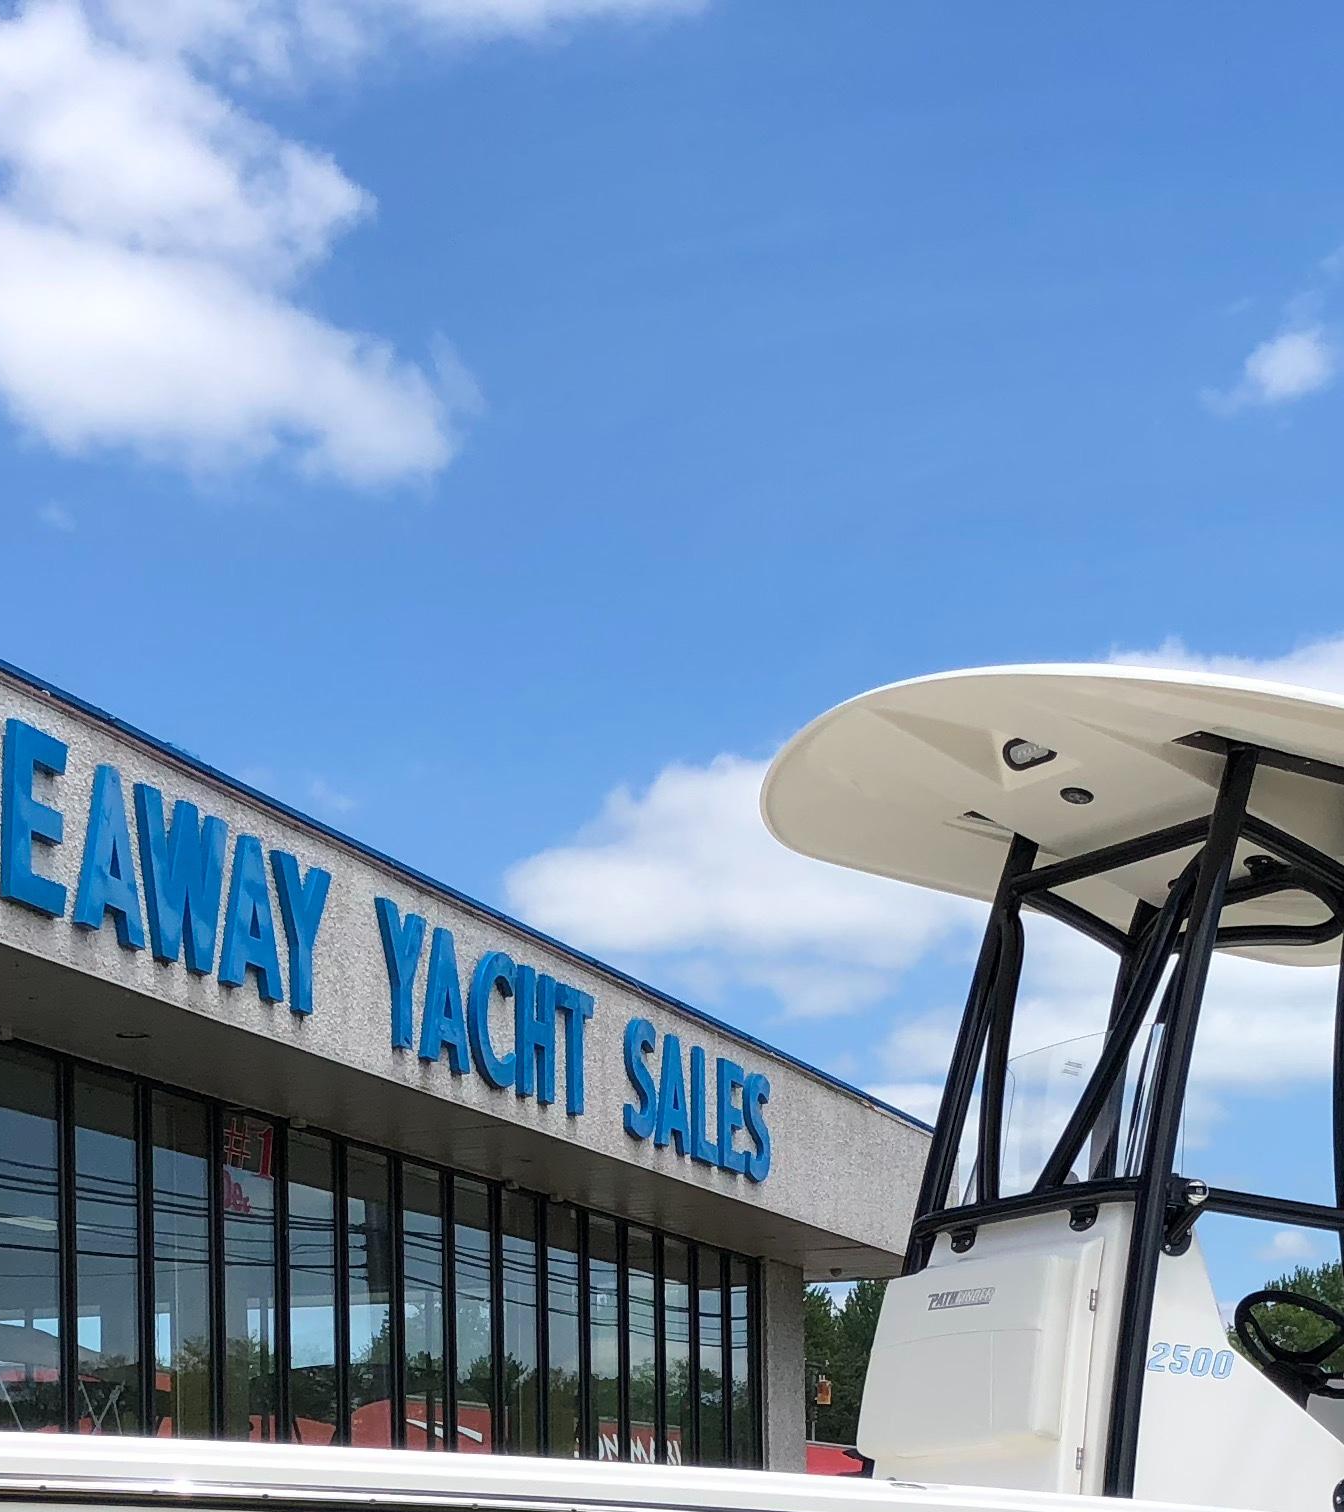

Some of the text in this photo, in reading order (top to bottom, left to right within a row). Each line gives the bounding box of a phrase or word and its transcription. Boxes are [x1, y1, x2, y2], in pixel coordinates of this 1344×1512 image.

[375, 898, 593, 1115] YACHT
[624, 1020, 770, 1182] SALES
[1147, 1342, 1234, 1379] 2500
